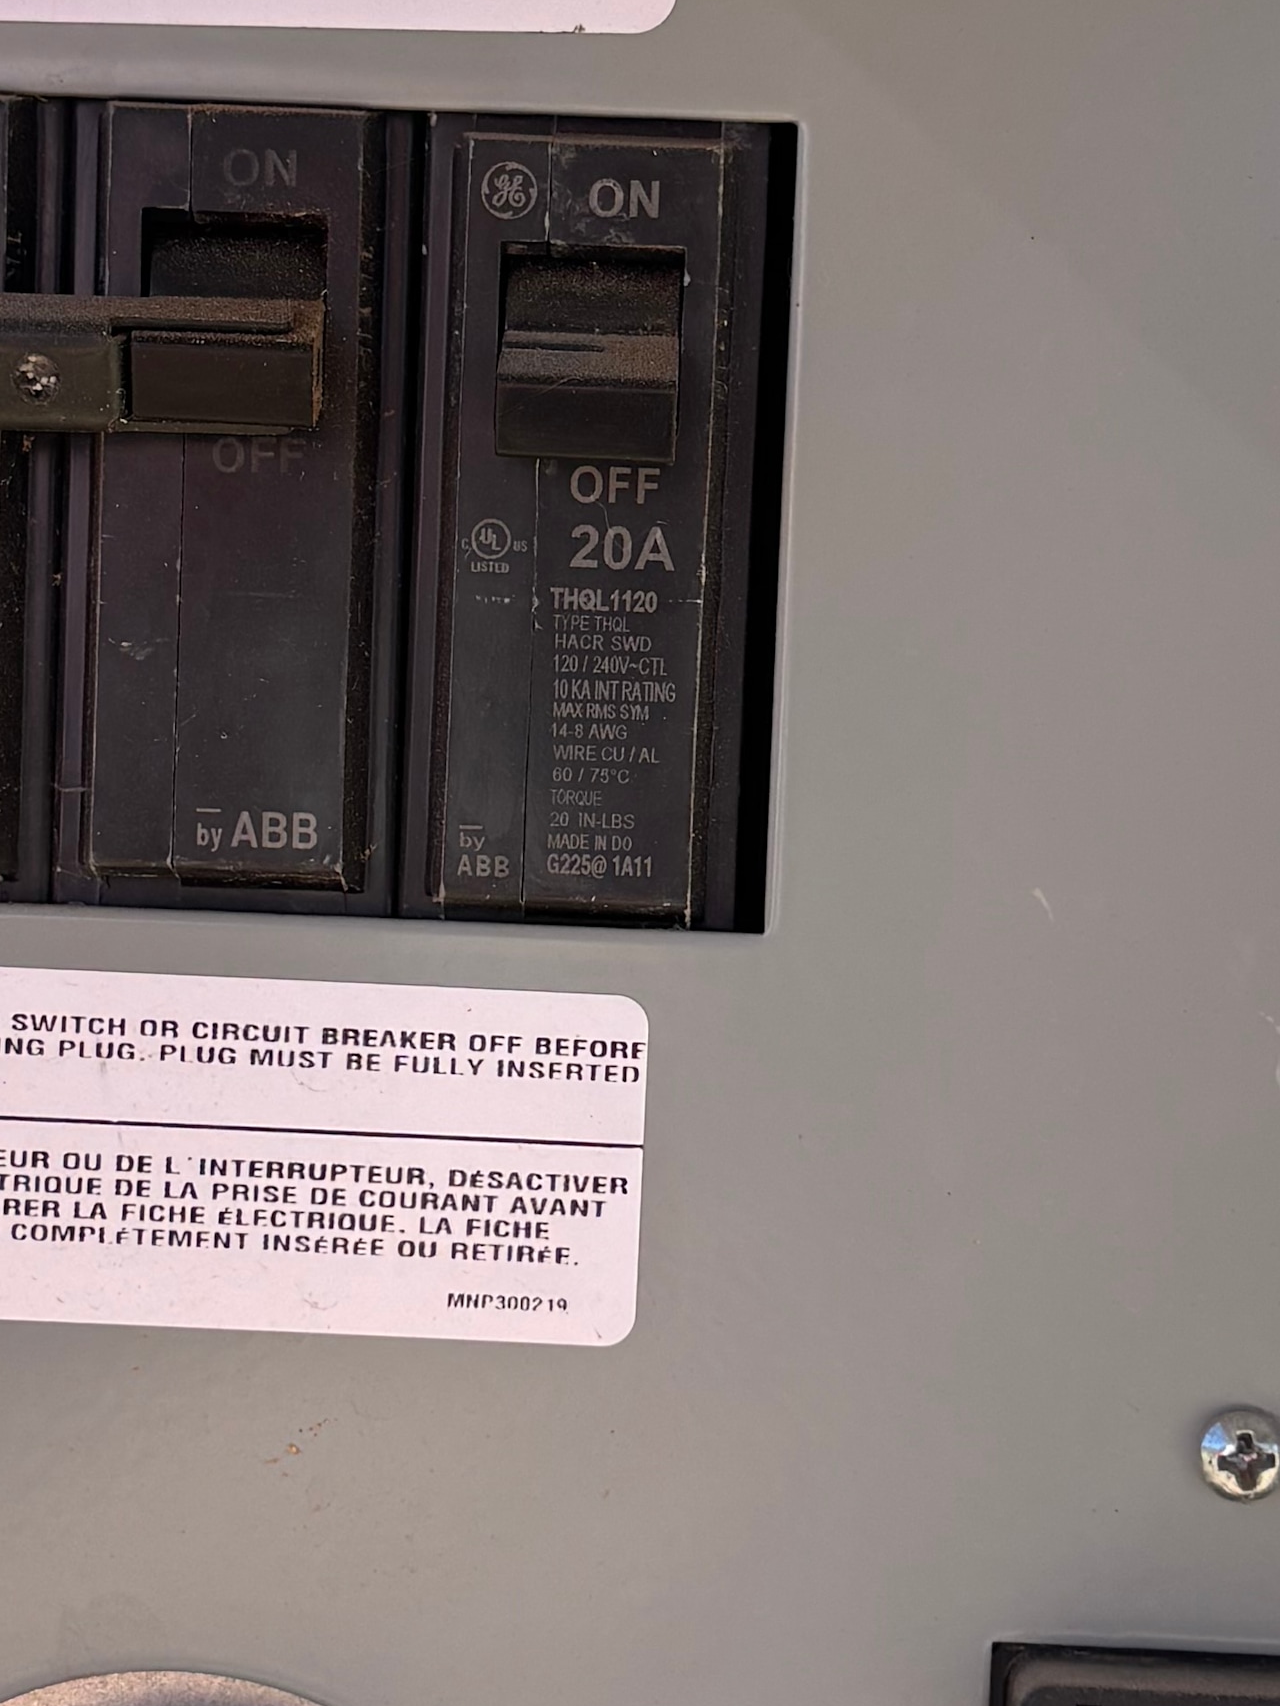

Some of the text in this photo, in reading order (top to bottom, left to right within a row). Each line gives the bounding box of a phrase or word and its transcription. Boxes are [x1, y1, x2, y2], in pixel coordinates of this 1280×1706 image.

[222, 147, 298, 188] ON
[588, 177, 661, 220] ON
[211, 436, 307, 474] OFF
[570, 466, 661, 506] OFF
[570, 525, 676, 572] 20A
[551, 587, 658, 614] THQL1120
[555, 633, 651, 651] HACR SWD
[554, 654, 578, 672] 120
[589, 724, 627, 740] AWG
[195, 810, 319, 853] by ABB
[550, 812, 634, 829] 20 IN-LBS
[459, 831, 486, 852] by
[457, 854, 509, 878] ABB
[613, 855, 651, 877] 1A11
[11, 1013, 126, 1037] SWITCH
[139, 1019, 179, 1039] OR
[191, 1021, 310, 1045] CIRCUIT
[321, 1027, 456, 1052] BREAKER
[468, 1034, 523, 1054] OFF
[535, 1036, 646, 1060] BEFORE
[58, 1039, 148, 1062] PLUG.
[159, 1044, 237, 1065] PLUG
[249, 1048, 333, 1069] MUST
[346, 1052, 381, 1072] BE
[393, 1054, 485, 1076] FULLY
[497, 1059, 640, 1083] INSERTED
